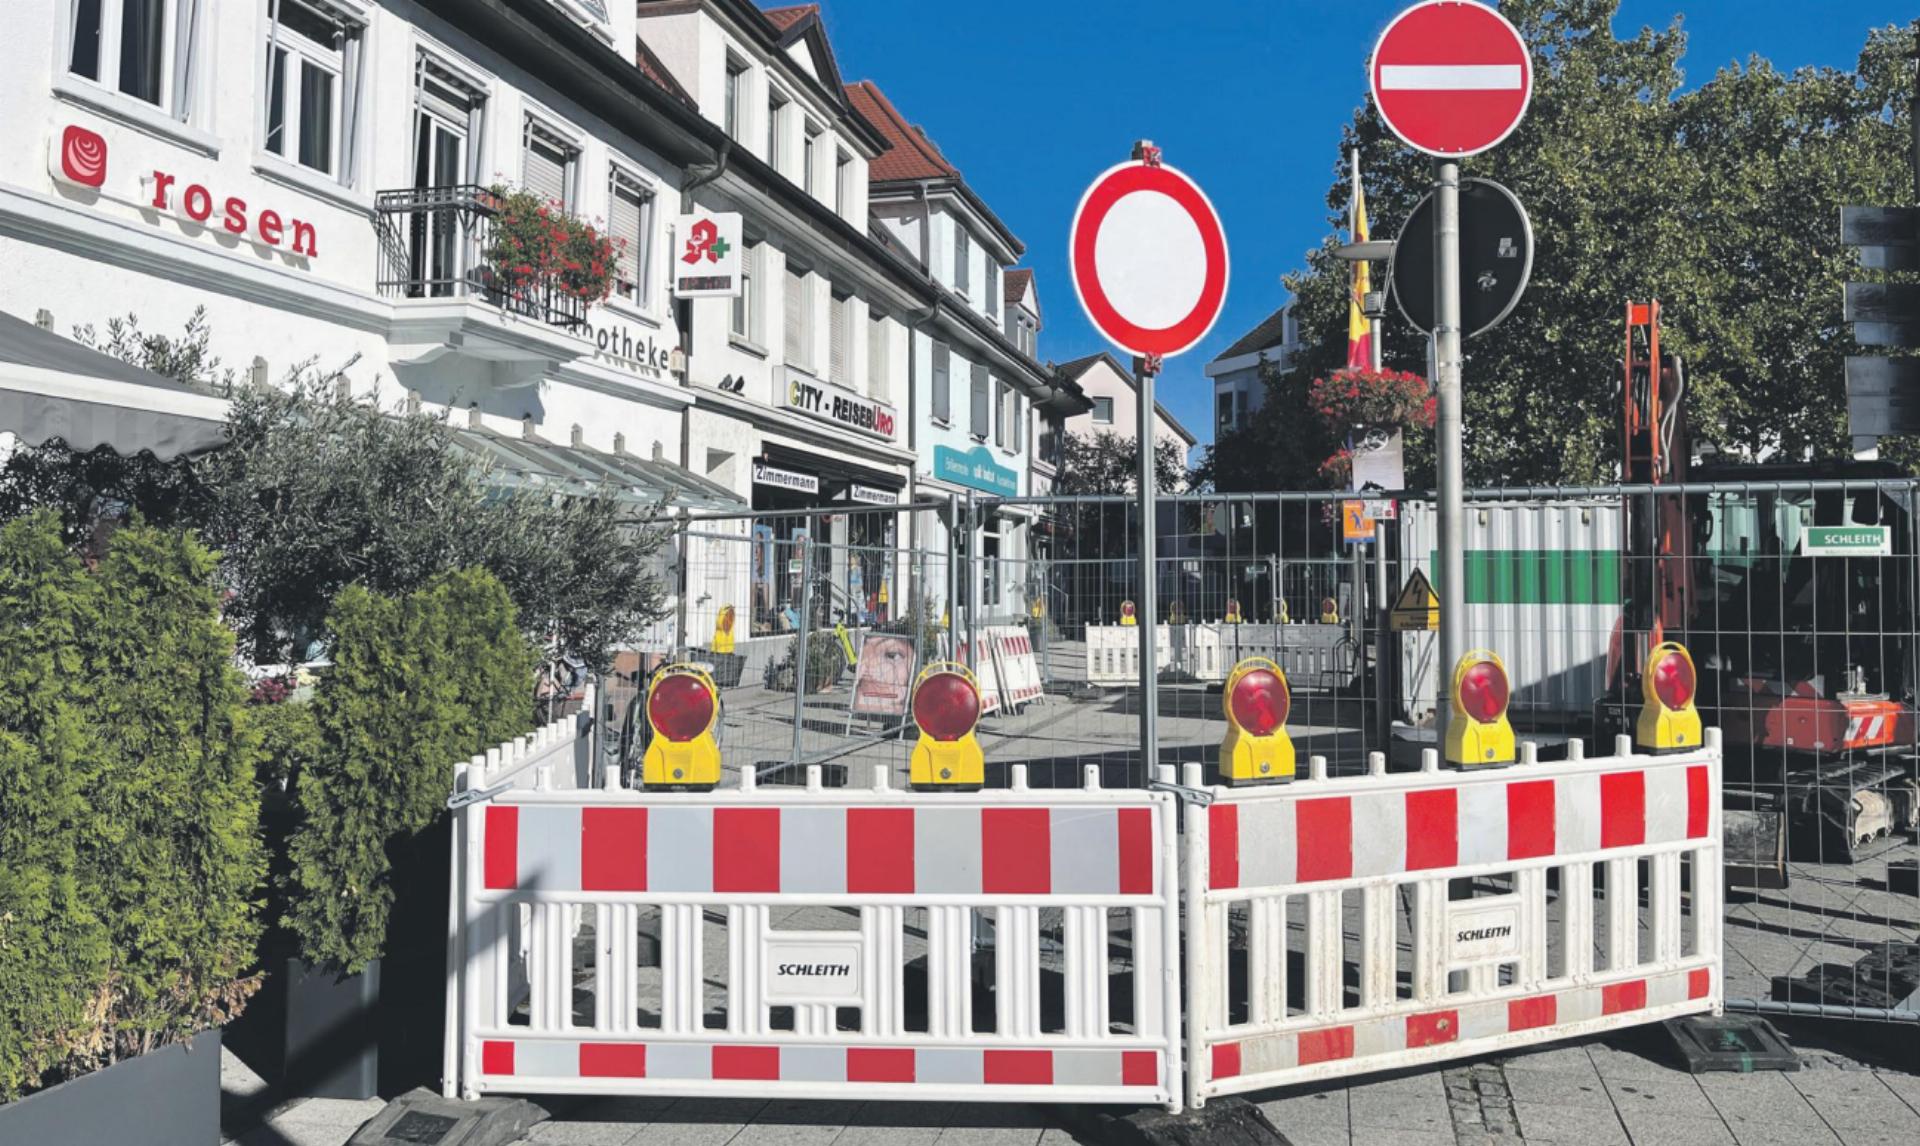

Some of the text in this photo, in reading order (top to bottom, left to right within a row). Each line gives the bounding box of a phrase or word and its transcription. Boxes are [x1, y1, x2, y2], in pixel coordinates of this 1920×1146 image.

[152, 170, 318, 258] rosen
[789, 380, 823, 412] CITY
[755, 465, 816, 490] Zimmermann
[853, 485, 897, 504] Zimmermann
[1824, 533, 1881, 545] SCHLEITH
[1456, 925, 1512, 943] SCHLEITH
[777, 963, 850, 976] SCHLEITH
